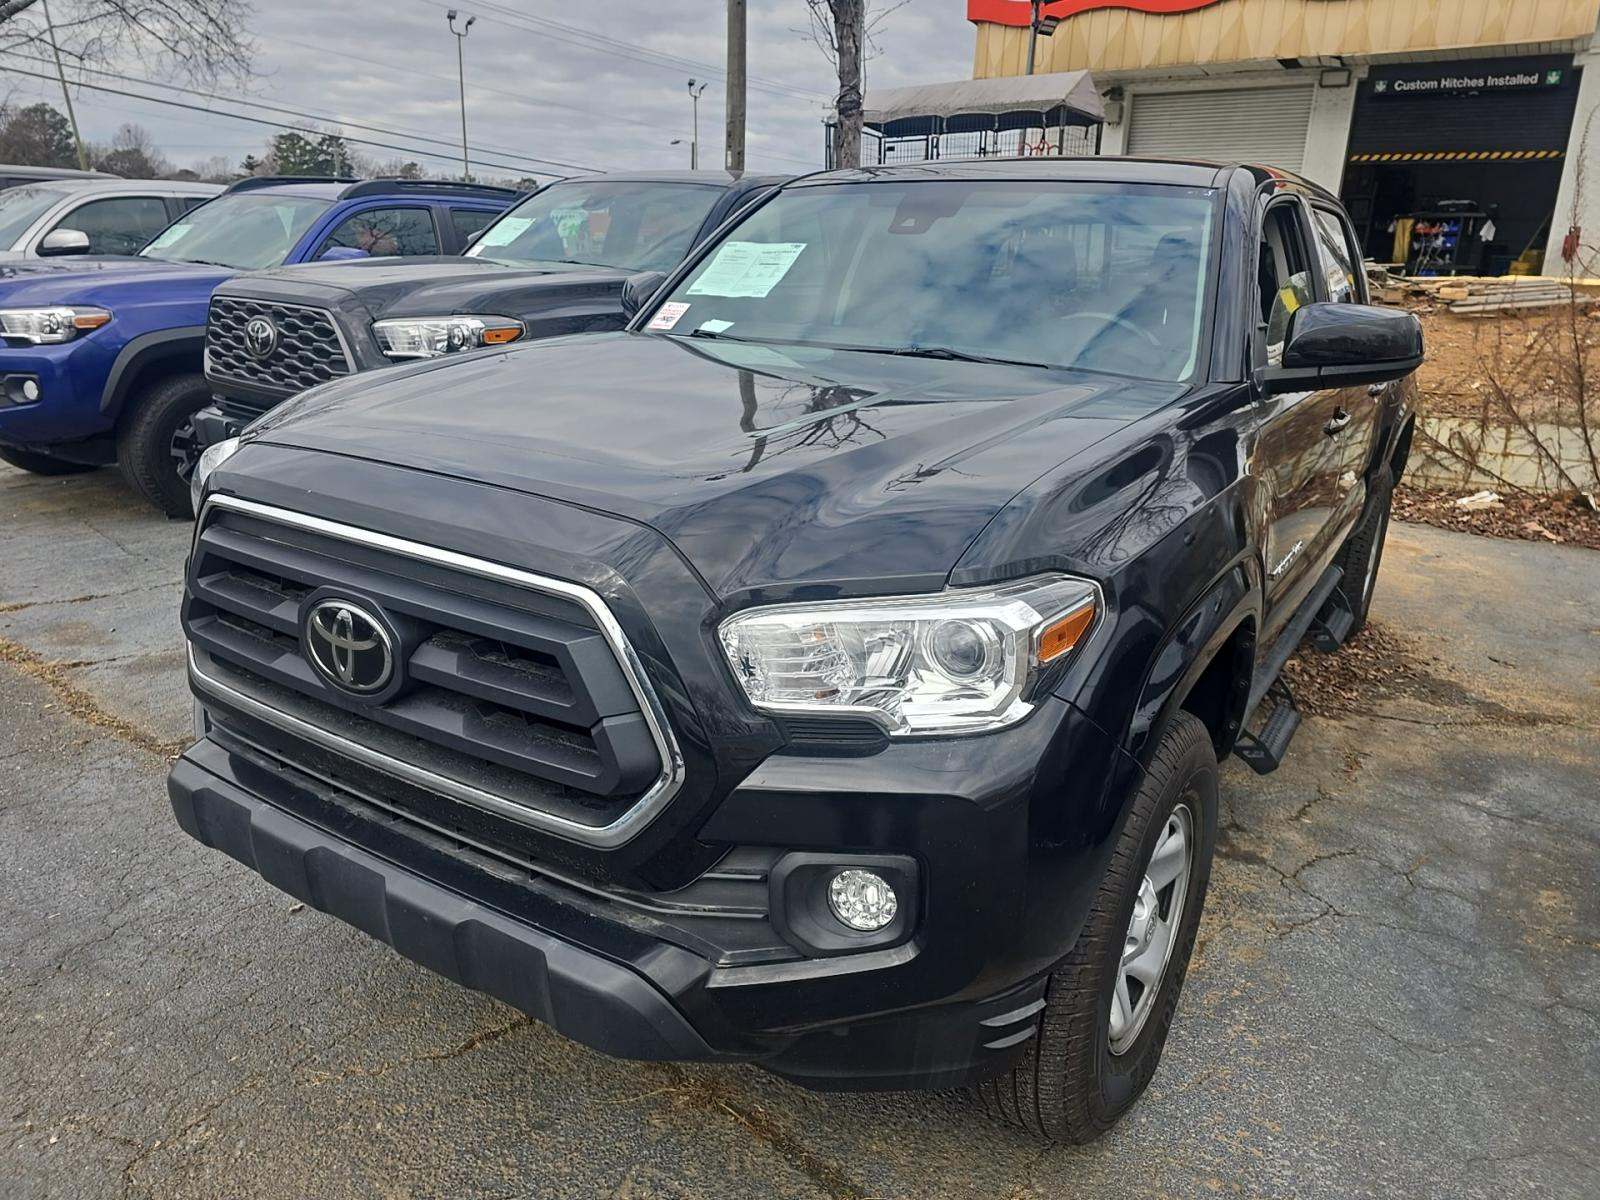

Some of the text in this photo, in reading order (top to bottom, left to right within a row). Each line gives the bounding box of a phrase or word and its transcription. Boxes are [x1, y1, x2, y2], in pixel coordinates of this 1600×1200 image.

[1394, 73, 1539, 91] Custom Hitches Installed
